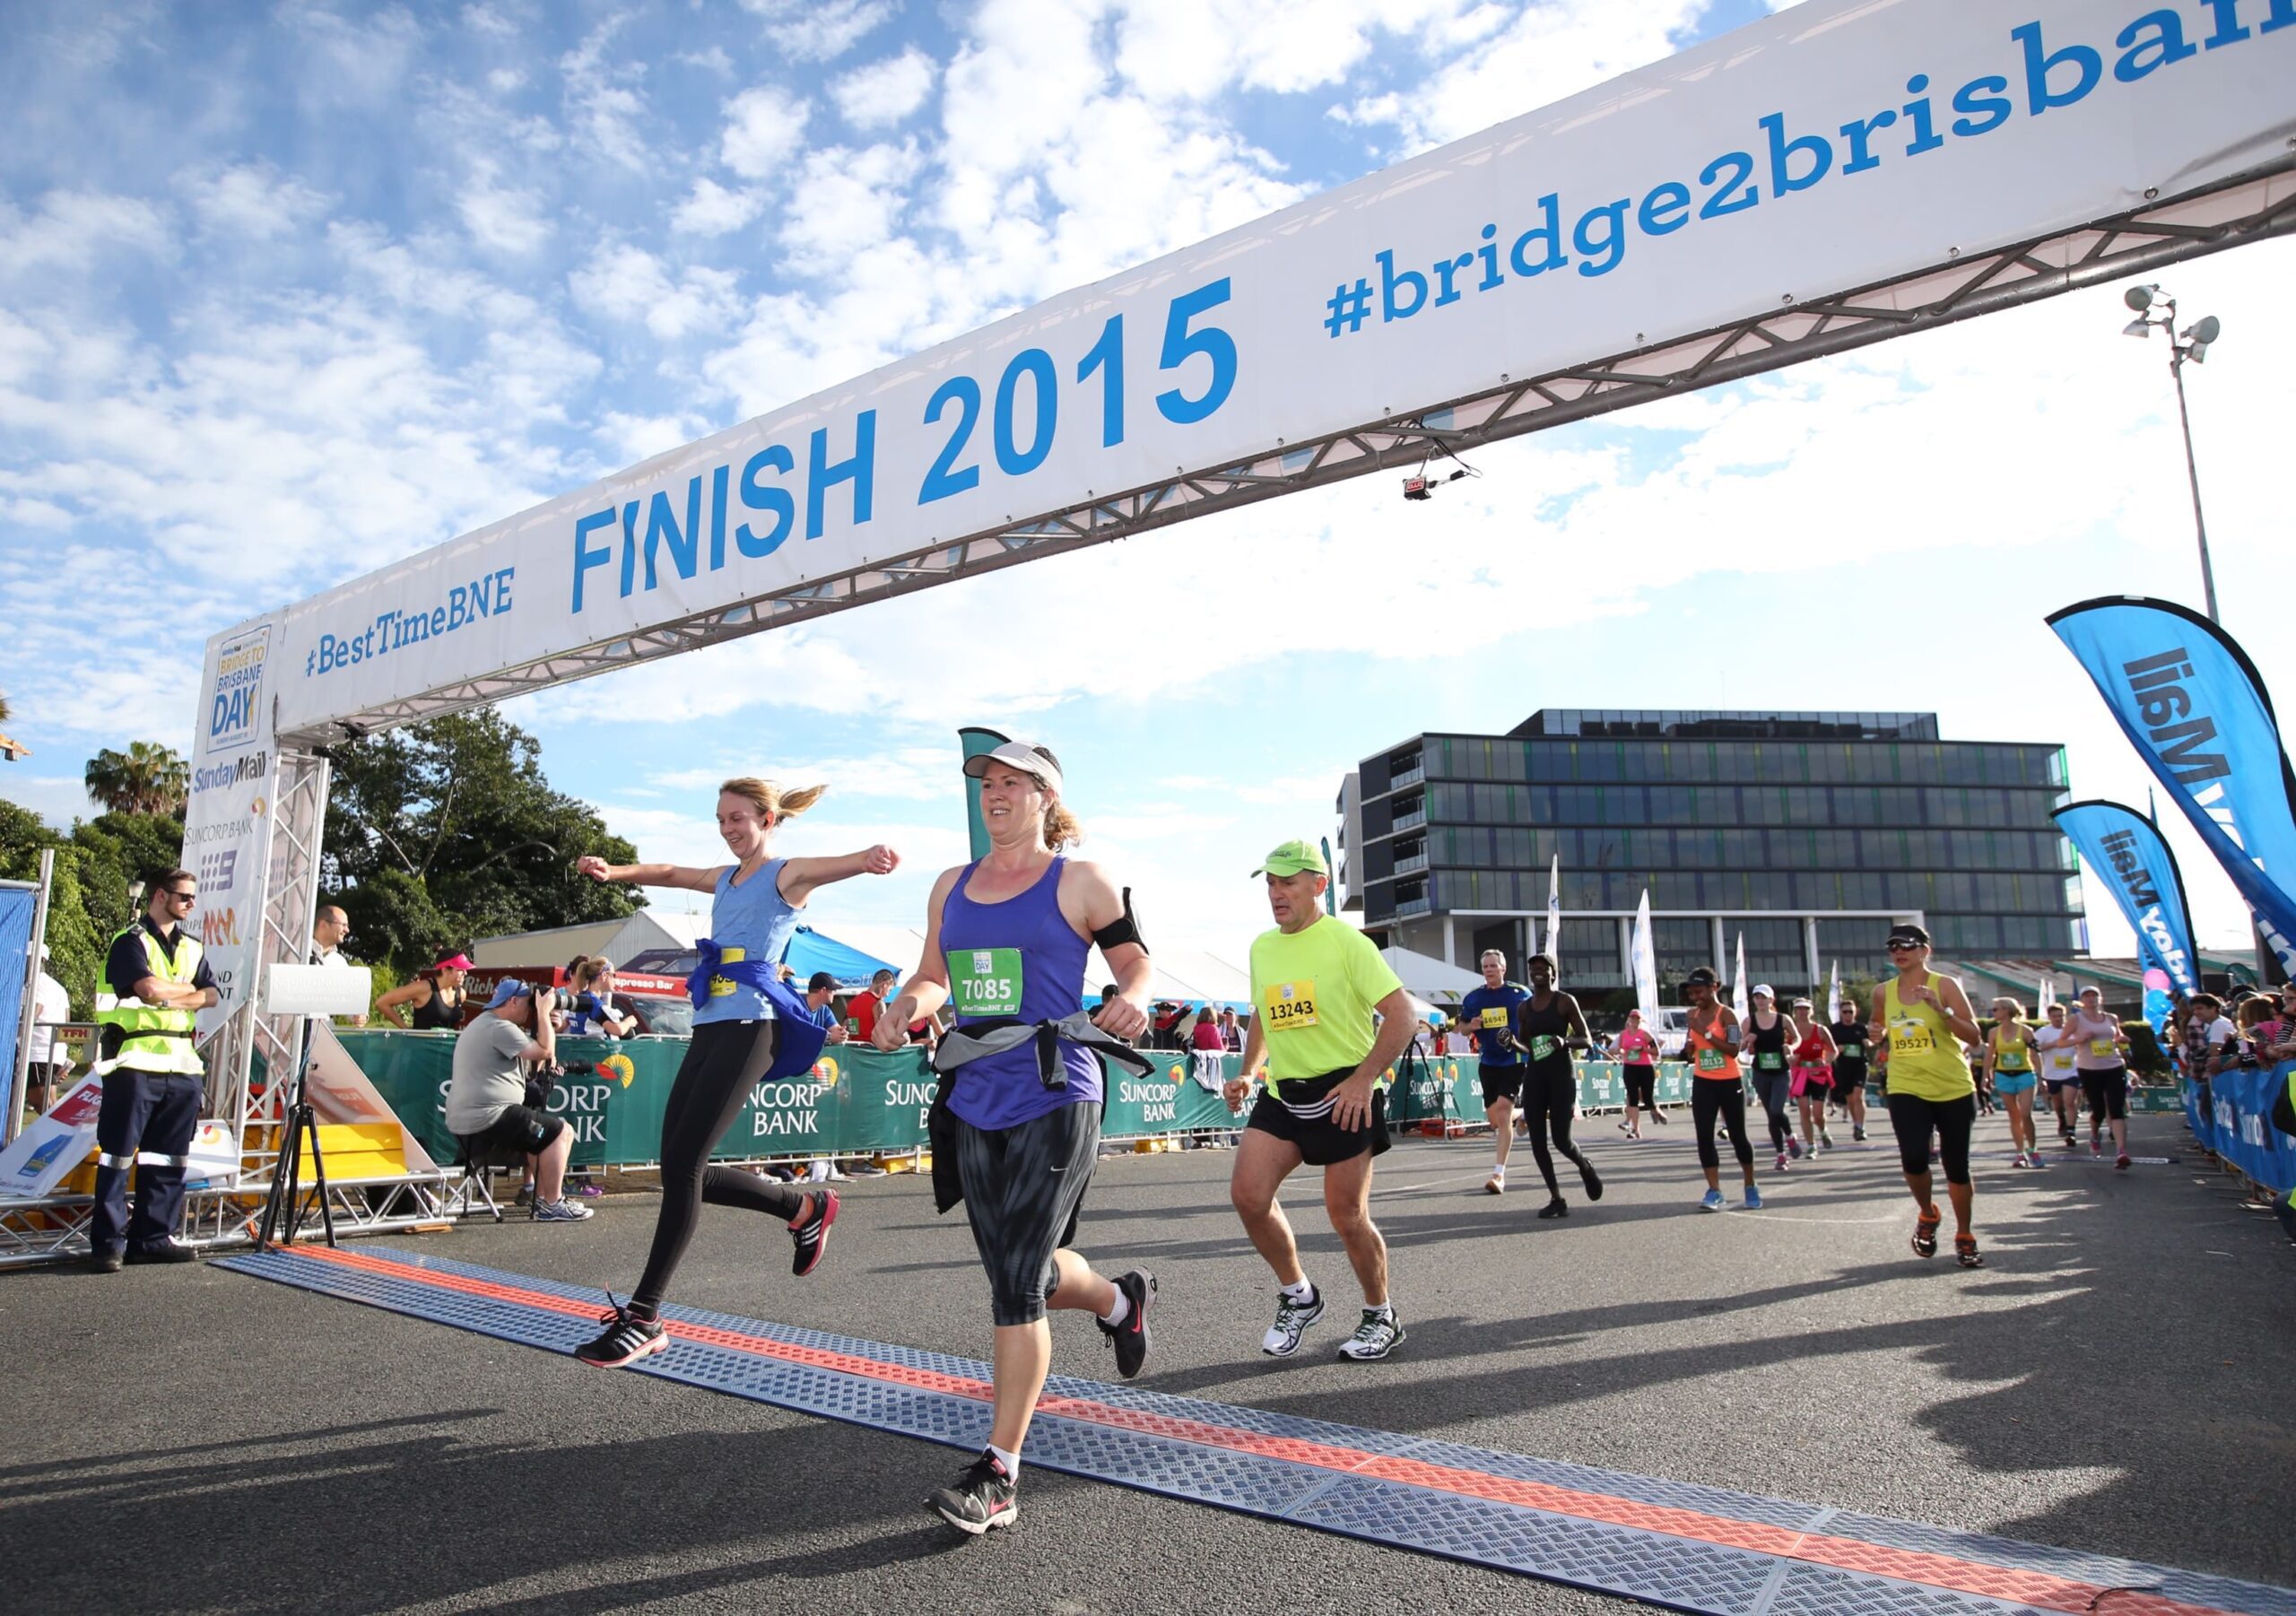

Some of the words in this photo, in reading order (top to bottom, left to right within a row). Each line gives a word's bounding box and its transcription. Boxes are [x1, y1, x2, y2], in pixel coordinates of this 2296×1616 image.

[571, 409, 876, 613] FINISH
[917, 276, 1238, 506] 2015
[305, 567, 515, 677] #BestTimeBNE
[220, 650, 250, 674] BRIDGE
[252, 646, 265, 664] TO
[217, 664, 262, 691] BRISBANE
[211, 683, 257, 736] DAY
[184, 823, 228, 846] SUNCORP
[228, 818, 254, 838] BANK
[657, 980, 674, 990] Bar
[961, 978, 1012, 1000] 7085
[1270, 1000, 1314, 1021] 13243
[62, 1029, 88, 1038] TFH
[1894, 1038, 1929, 1049] 19527
[1119, 1082, 1176, 1103] SUNCORP
[753, 1110, 819, 1137] BANK
[1144, 1102, 1177, 1122] BANK
